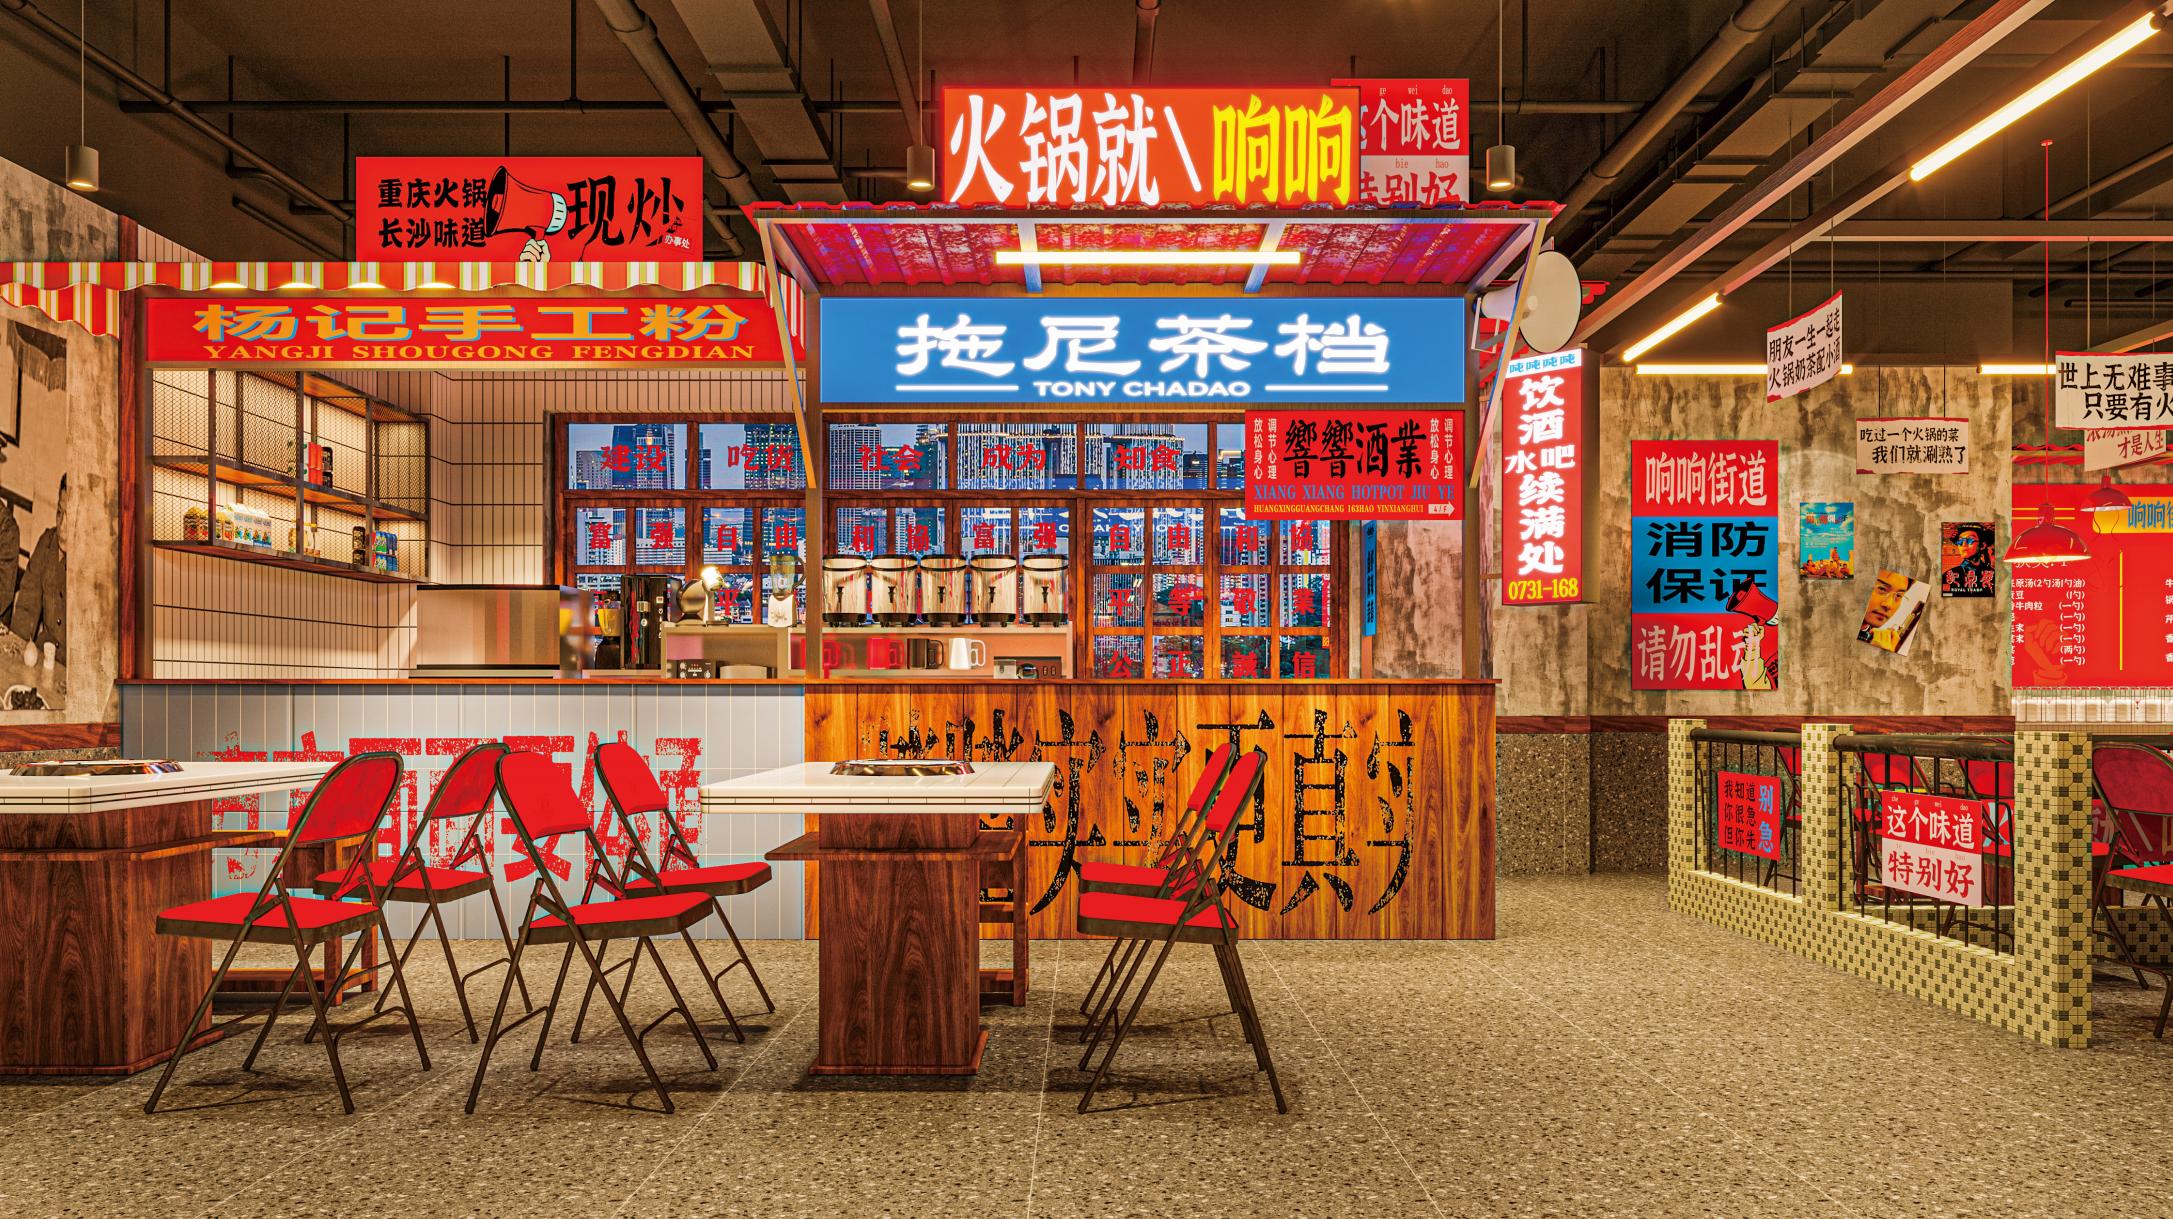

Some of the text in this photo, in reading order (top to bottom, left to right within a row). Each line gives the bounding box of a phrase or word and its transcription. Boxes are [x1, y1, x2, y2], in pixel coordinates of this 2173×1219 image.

[1408, 85, 1418, 94] wei
[1442, 85, 1452, 94] dao
[1396, 159, 1449, 168] bie hao
[378, 178, 488, 208] 重庆火锅
[378, 218, 487, 248] 长沙味道
[193, 304, 747, 341] 杨记手工粉
[1769, 307, 1841, 363] 朋友一生一起走
[203, 345, 756, 359] YANGJI SHOUGONG FENGDIAN
[895, 314, 1390, 376] 拖尼茶档
[1769, 336, 1841, 392] 火锅奶茶配小酒
[2058, 362, 2173, 391] 世上无难事
[1034, 381, 1251, 397] TONY CHADAO
[1254, 418, 1263, 480] 放松身心
[1268, 418, 1277, 480] 调节心理
[1283, 419, 1427, 479] 響響酒業
[1430, 418, 1440, 480] 放松身心
[1444, 418, 1454, 480] 调节心理
[1860, 427, 1959, 442] 吃过一个火锅的菜
[600, 443, 1181, 473] 建设 吃货 社会 成为 知食
[1872, 445, 1966, 464] 我们就涮熟了
[1254, 485, 1455, 500] XIANG XIANG HOTPOT JIU YE
[1645, 450, 1767, 506] 响响街道
[1254, 504, 1344, 513] HUANGXINGGUANGCHANG
[1348, 504, 1374, 513] 163HAO
[1647, 521, 1768, 557] 消防
[1508, 578, 1578, 601] 0731-168
[1638, 625, 1760, 682] 请勿乱动
[1724, 780, 1755, 802] 我知道
[1724, 803, 1756, 827] 你很急
[1887, 805, 1975, 849] 这个味道
[1724, 825, 1755, 850] 但你先
[1888, 851, 1975, 898] 特别好
